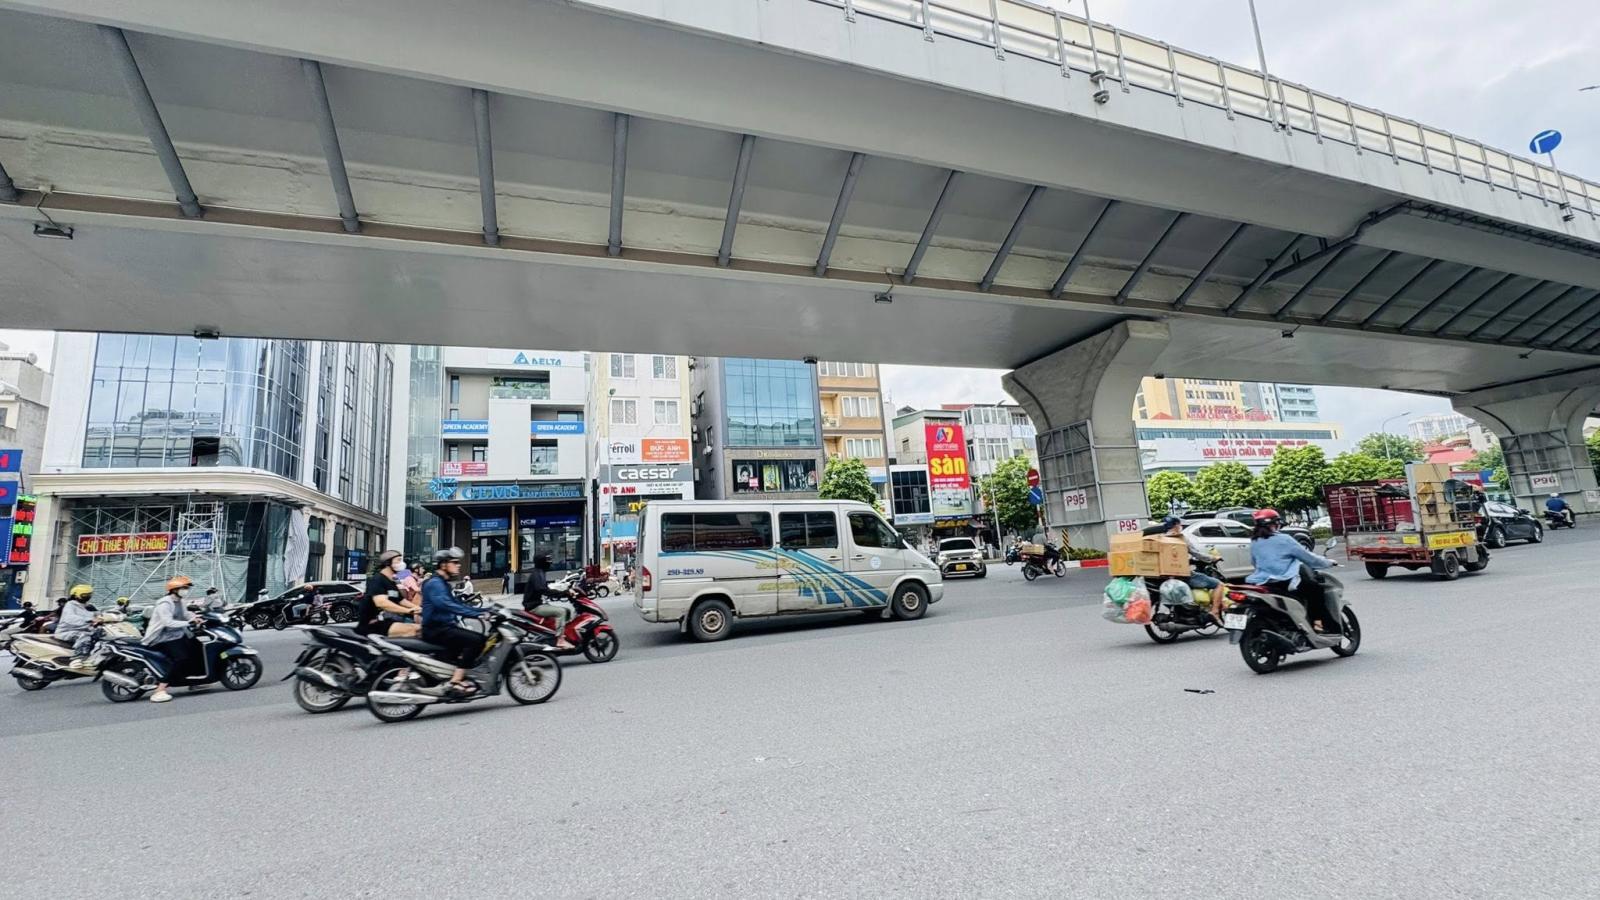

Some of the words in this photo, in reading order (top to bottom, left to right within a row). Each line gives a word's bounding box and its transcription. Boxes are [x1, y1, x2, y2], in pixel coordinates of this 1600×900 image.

[531, 358, 562, 366] DELTA
[930, 453, 967, 475] sàn
[621, 485, 636, 494] ANH
[1066, 494, 1085, 506] P95
[1119, 519, 1138, 532] P95
